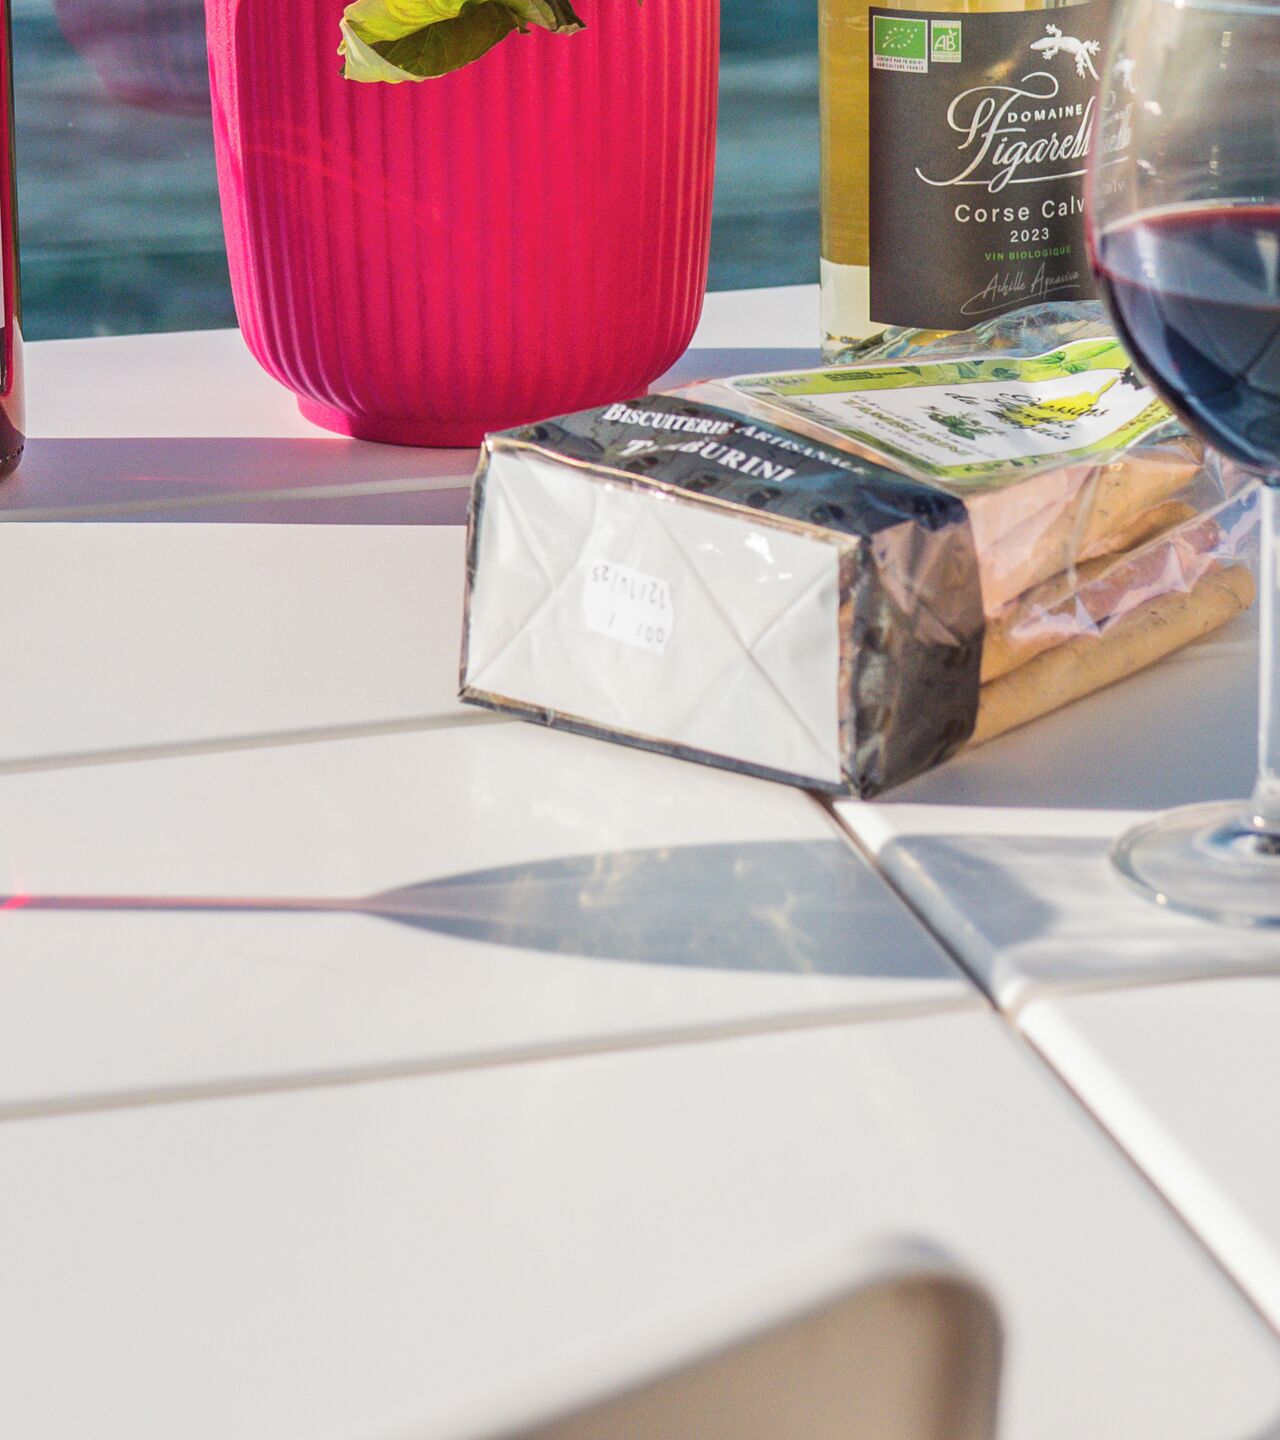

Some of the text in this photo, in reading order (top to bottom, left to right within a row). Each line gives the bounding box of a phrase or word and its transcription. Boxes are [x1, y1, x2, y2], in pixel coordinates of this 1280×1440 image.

[1007, 103, 1083, 123] DOMAINE
[925, 73, 1097, 194] Figarell
[955, 195, 1086, 224] Corse Calv
[1010, 227, 1050, 243] 2023
[984, 244, 1073, 261] VIN BIOLOGIQUE
[618, 438, 796, 482] TBURINI
